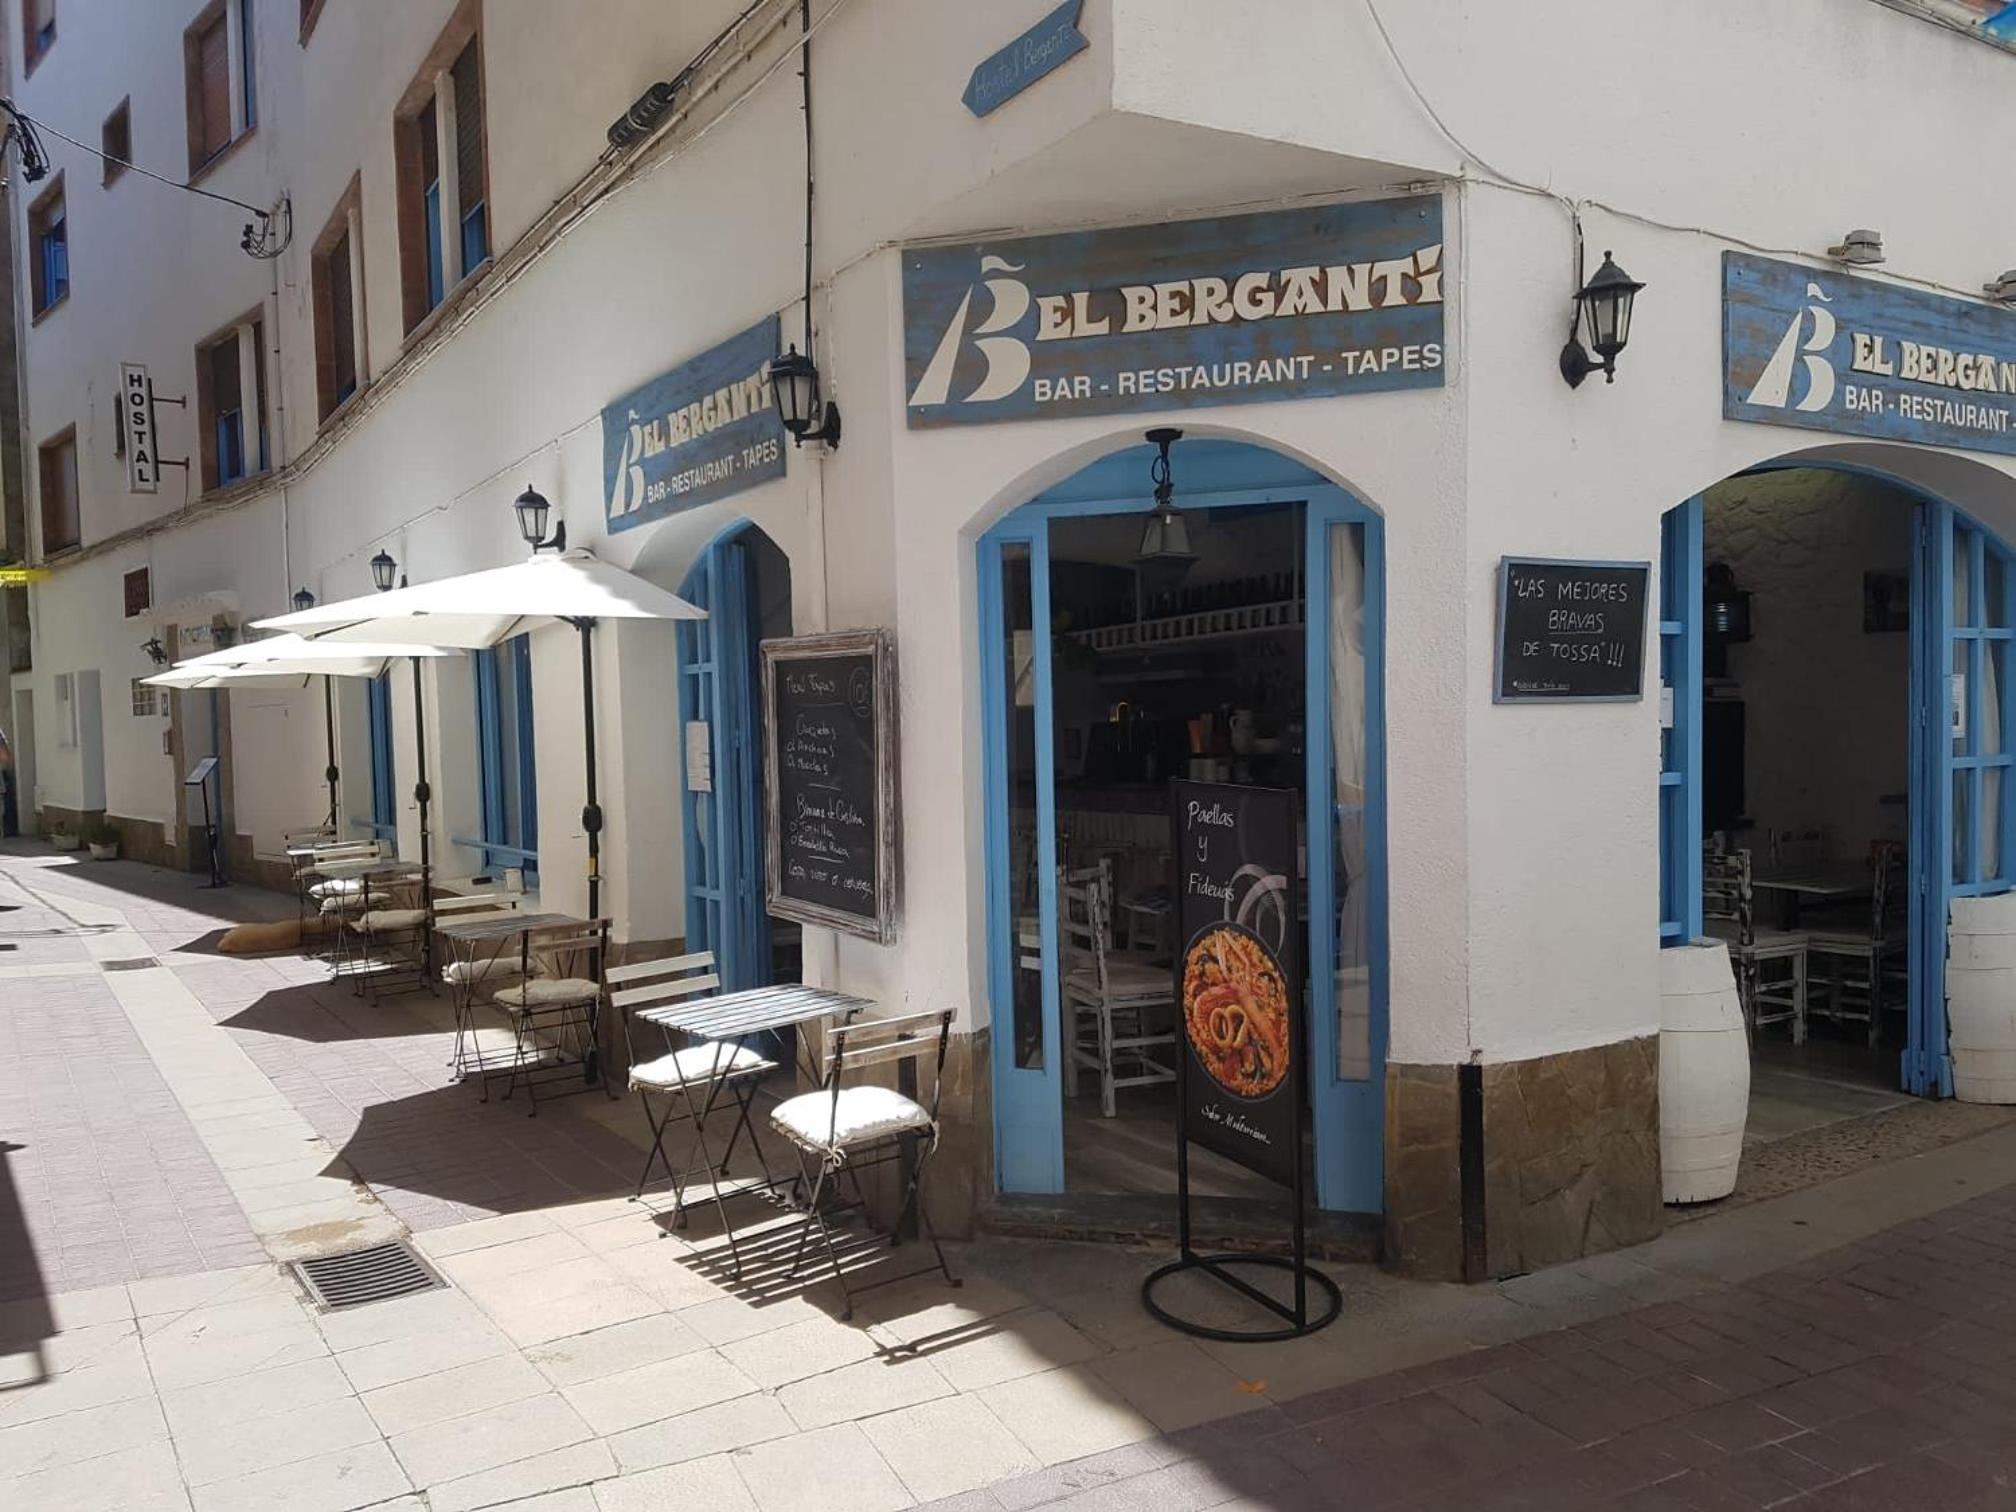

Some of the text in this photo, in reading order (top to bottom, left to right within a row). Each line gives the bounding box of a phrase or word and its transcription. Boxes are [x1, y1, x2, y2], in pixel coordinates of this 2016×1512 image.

[1035, 243, 1443, 341] EL BERGANTÍ
[1034, 375, 1091, 402] BAR
[1118, 355, 1315, 396] RESTAURANT
[1341, 343, 1442, 376] TAPES
[1851, 332, 1893, 376] EL
[128, 373, 150, 482] HOSTAL
[1845, 386, 1884, 413] BAR
[1900, 394, 2009, 433] RESTAURANT
[643, 419, 666, 458] EL
[647, 480, 666, 504] BAR
[671, 455, 734, 495] RESTAURANT
[742, 438, 778, 469] TAPES
[1557, 581, 1628, 602] MEJORES
[1548, 609, 1605, 633] BRAVAS
[1522, 641, 1540, 657] DE
[1187, 800, 1235, 831] Paellas
[1196, 835, 1208, 862] y
[1188, 872, 1235, 901] Fideuás
